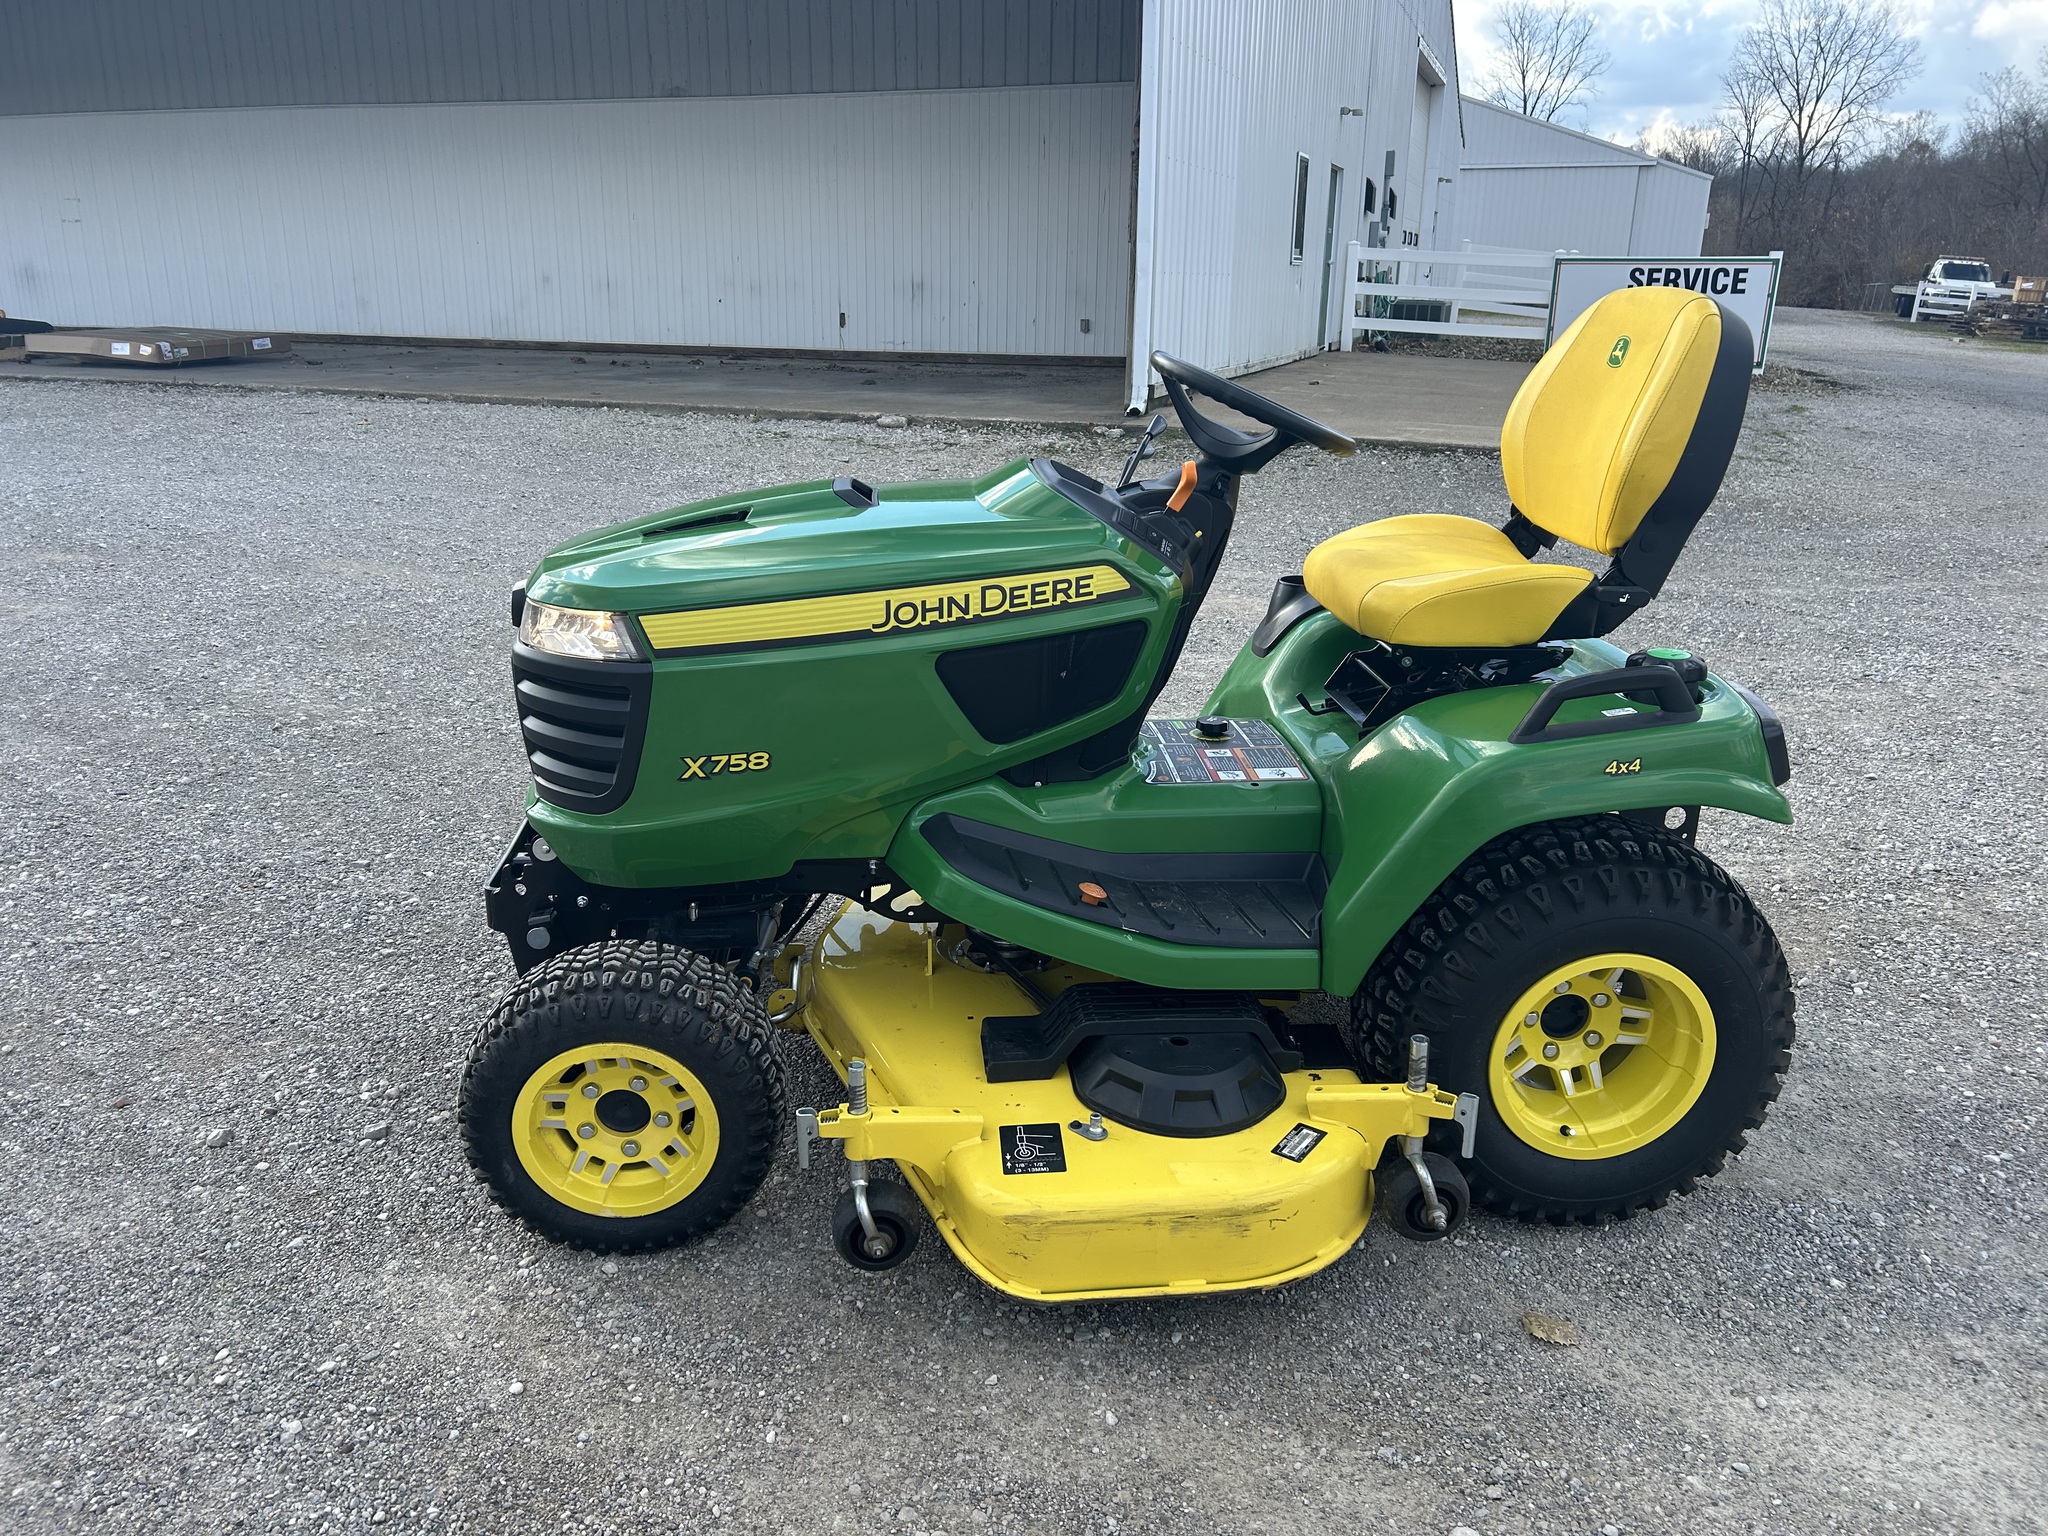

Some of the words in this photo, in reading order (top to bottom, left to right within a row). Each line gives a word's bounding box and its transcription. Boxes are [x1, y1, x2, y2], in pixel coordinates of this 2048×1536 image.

[1627, 267, 1749, 295] SERVICE
[871, 592, 971, 631] JOHN
[979, 573, 1096, 615] DEERE
[678, 750, 770, 780] X758
[1604, 758, 1642, 775] 4x4
